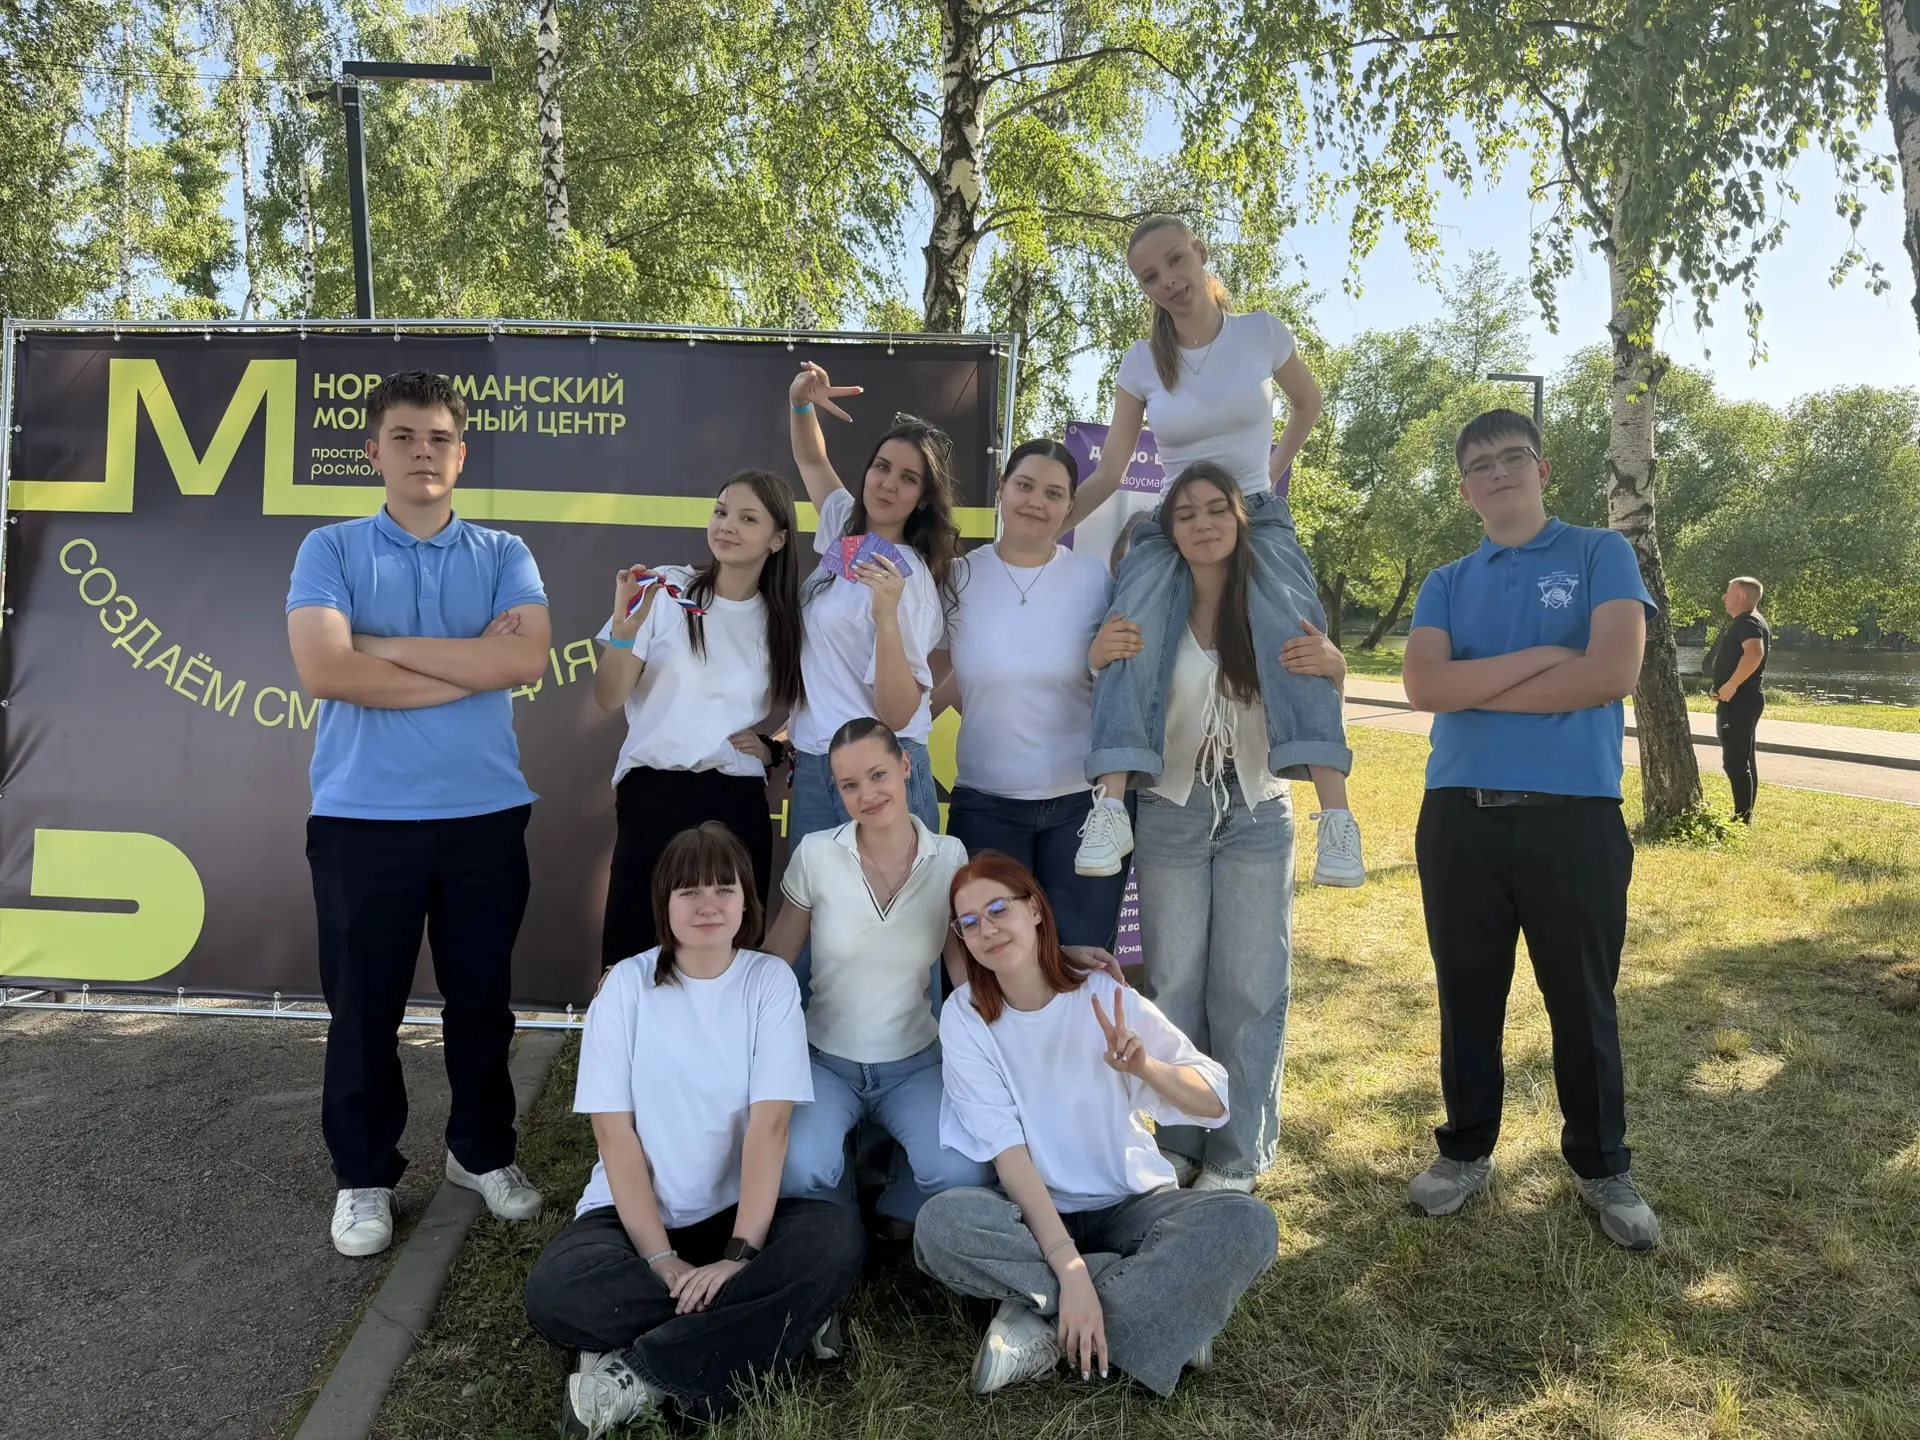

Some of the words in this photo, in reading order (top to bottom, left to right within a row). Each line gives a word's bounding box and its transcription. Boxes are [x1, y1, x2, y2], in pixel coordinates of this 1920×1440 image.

[313, 372, 624, 405] НОВМАНСКИЙ
[537, 410, 627, 437] ЦЕНТР
[59, 537, 247, 718] СОЗДАЁМ
[253, 686, 320, 730] СМ
